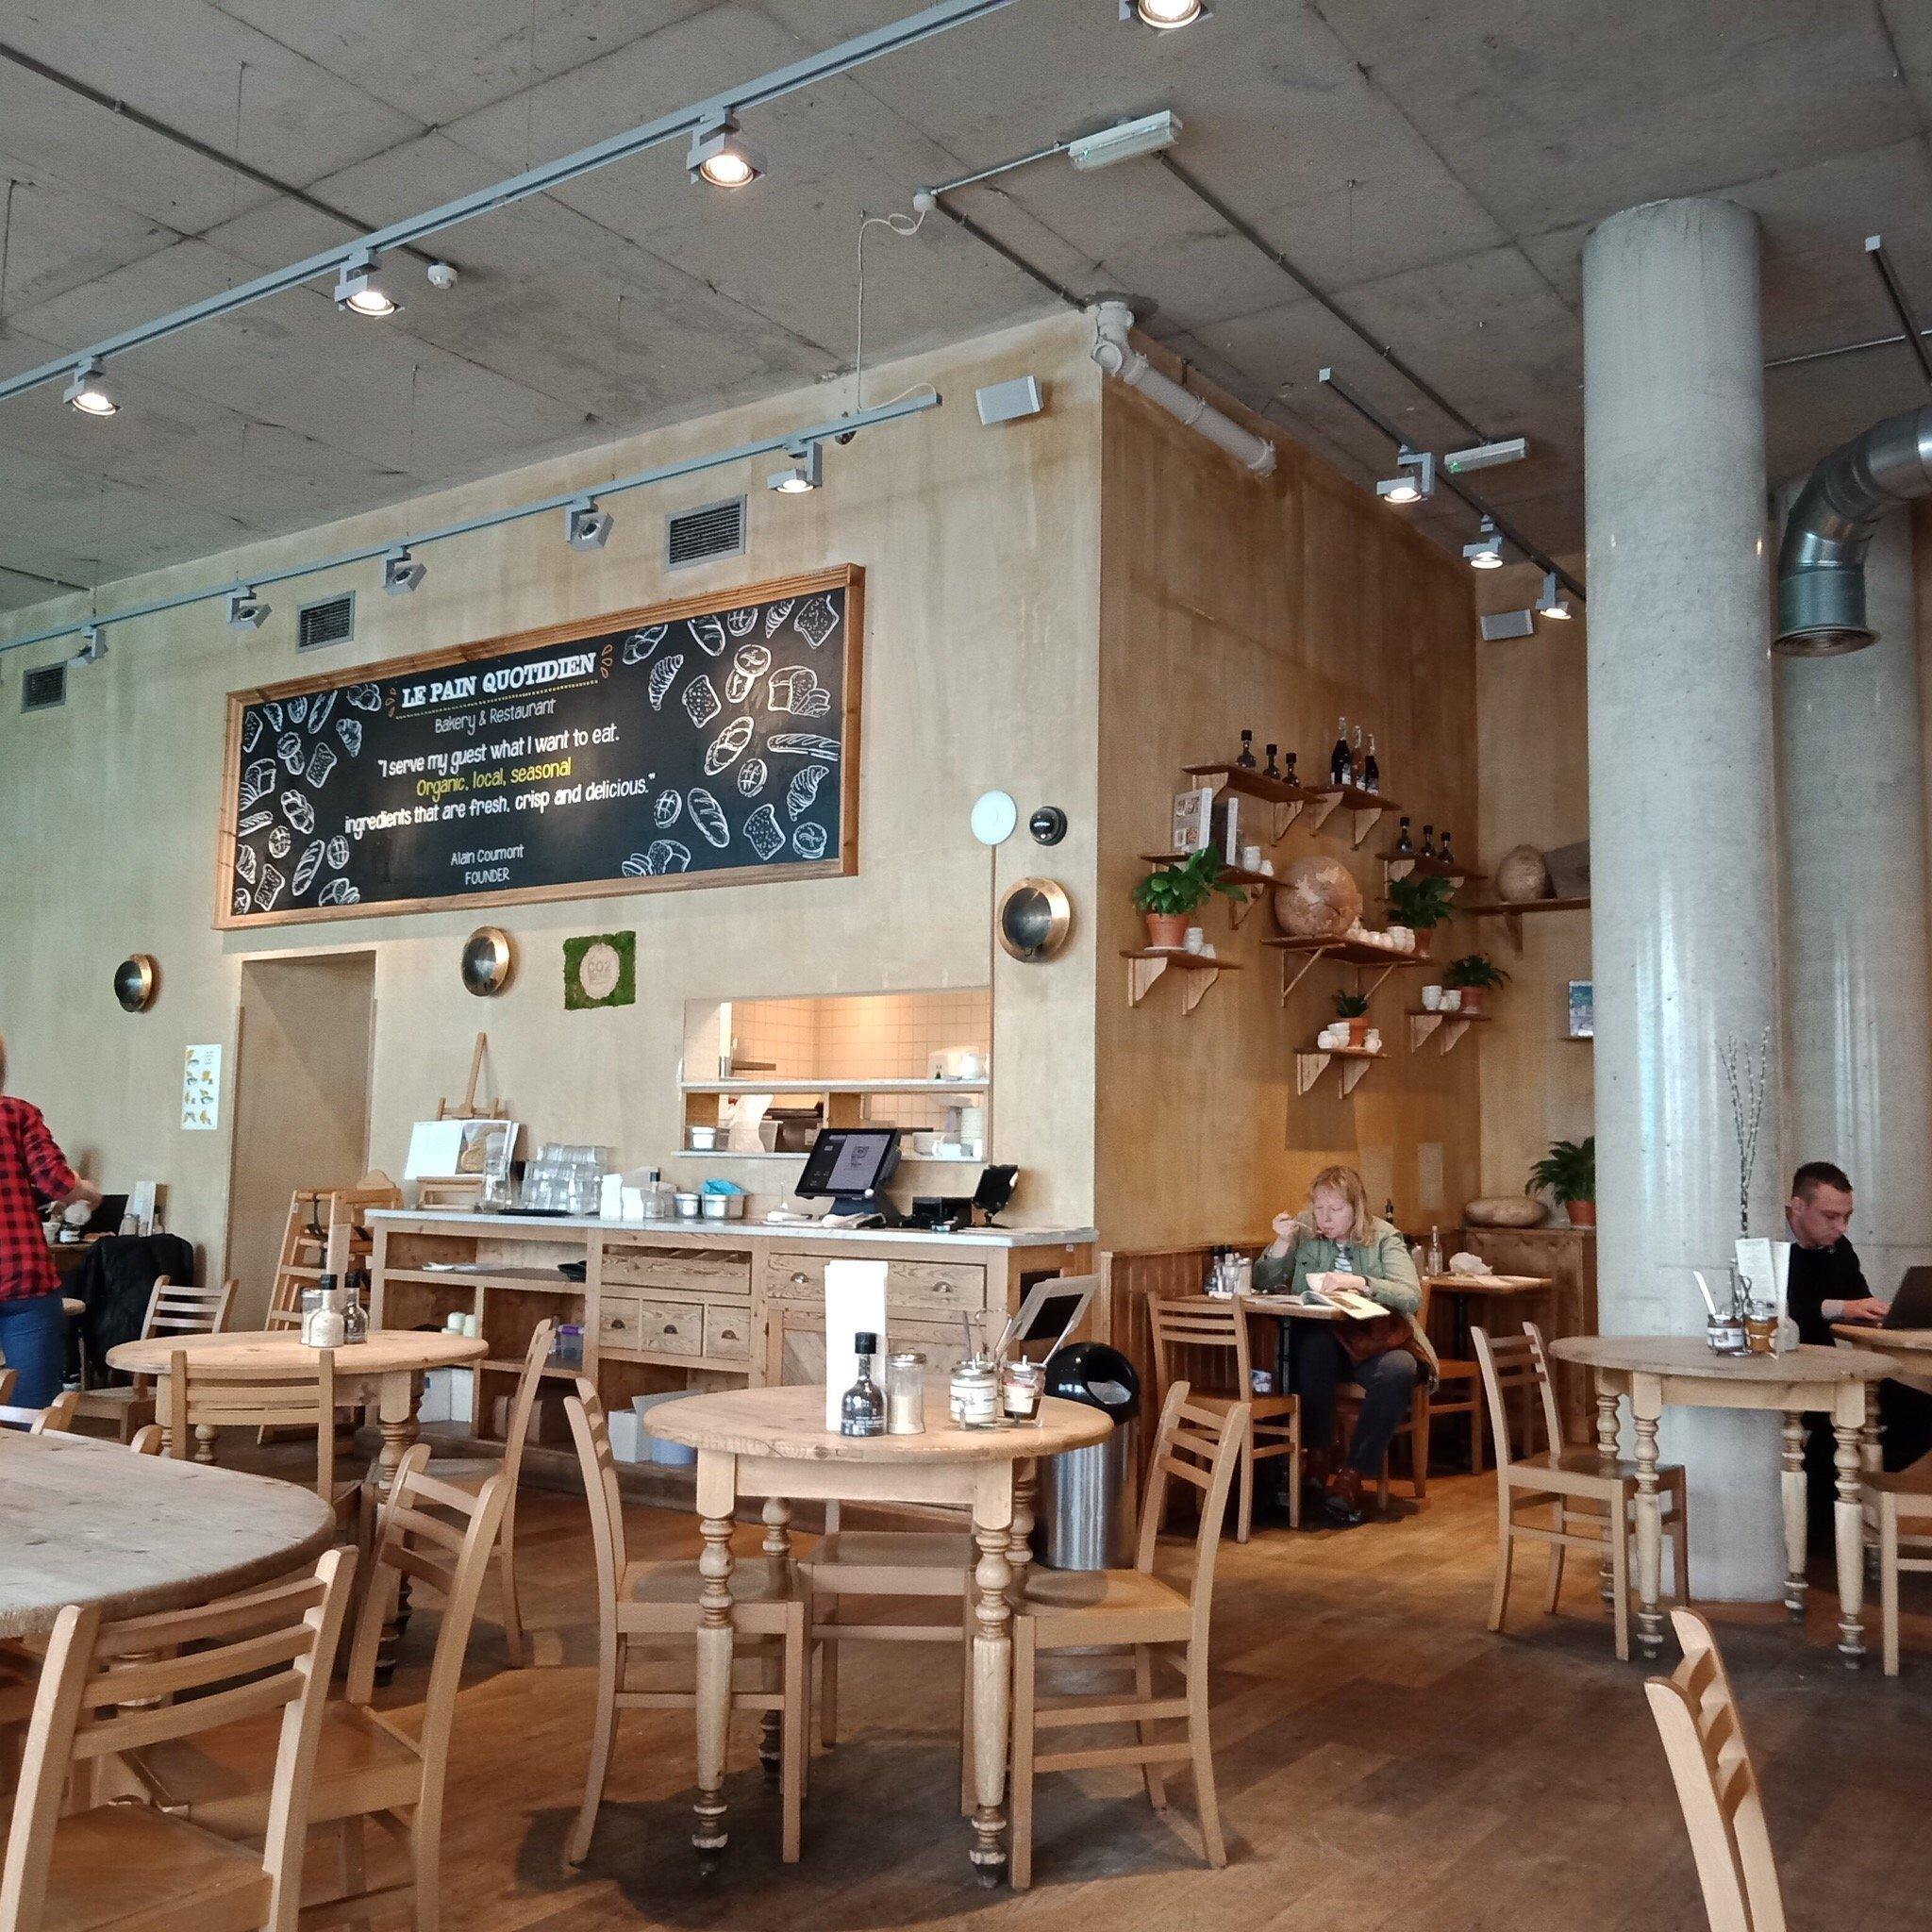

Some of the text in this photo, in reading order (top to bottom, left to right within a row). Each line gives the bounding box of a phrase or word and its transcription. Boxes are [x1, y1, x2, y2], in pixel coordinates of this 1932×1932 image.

[401, 652, 596, 708] LE PAIN QUOTIDIEN
[435, 698, 557, 736] Bakery & Restaurant
[389, 757, 425, 775] serve
[427, 753, 448, 776] my
[450, 743, 488, 774] guest
[490, 737, 525, 760] what
[527, 735, 532, 755] I
[535, 729, 570, 754] want
[573, 728, 589, 747] to
[591, 723, 620, 744] eat.
[510, 757, 572, 784] seasonal
[344, 808, 413, 841] ingredients
[413, 803, 441, 824] that
[441, 802, 466, 821] are
[514, 790, 551, 814] crisp
[554, 783, 583, 806] and
[451, 843, 525, 866] Alain Coumont
[464, 867, 510, 885] FOUNDER
